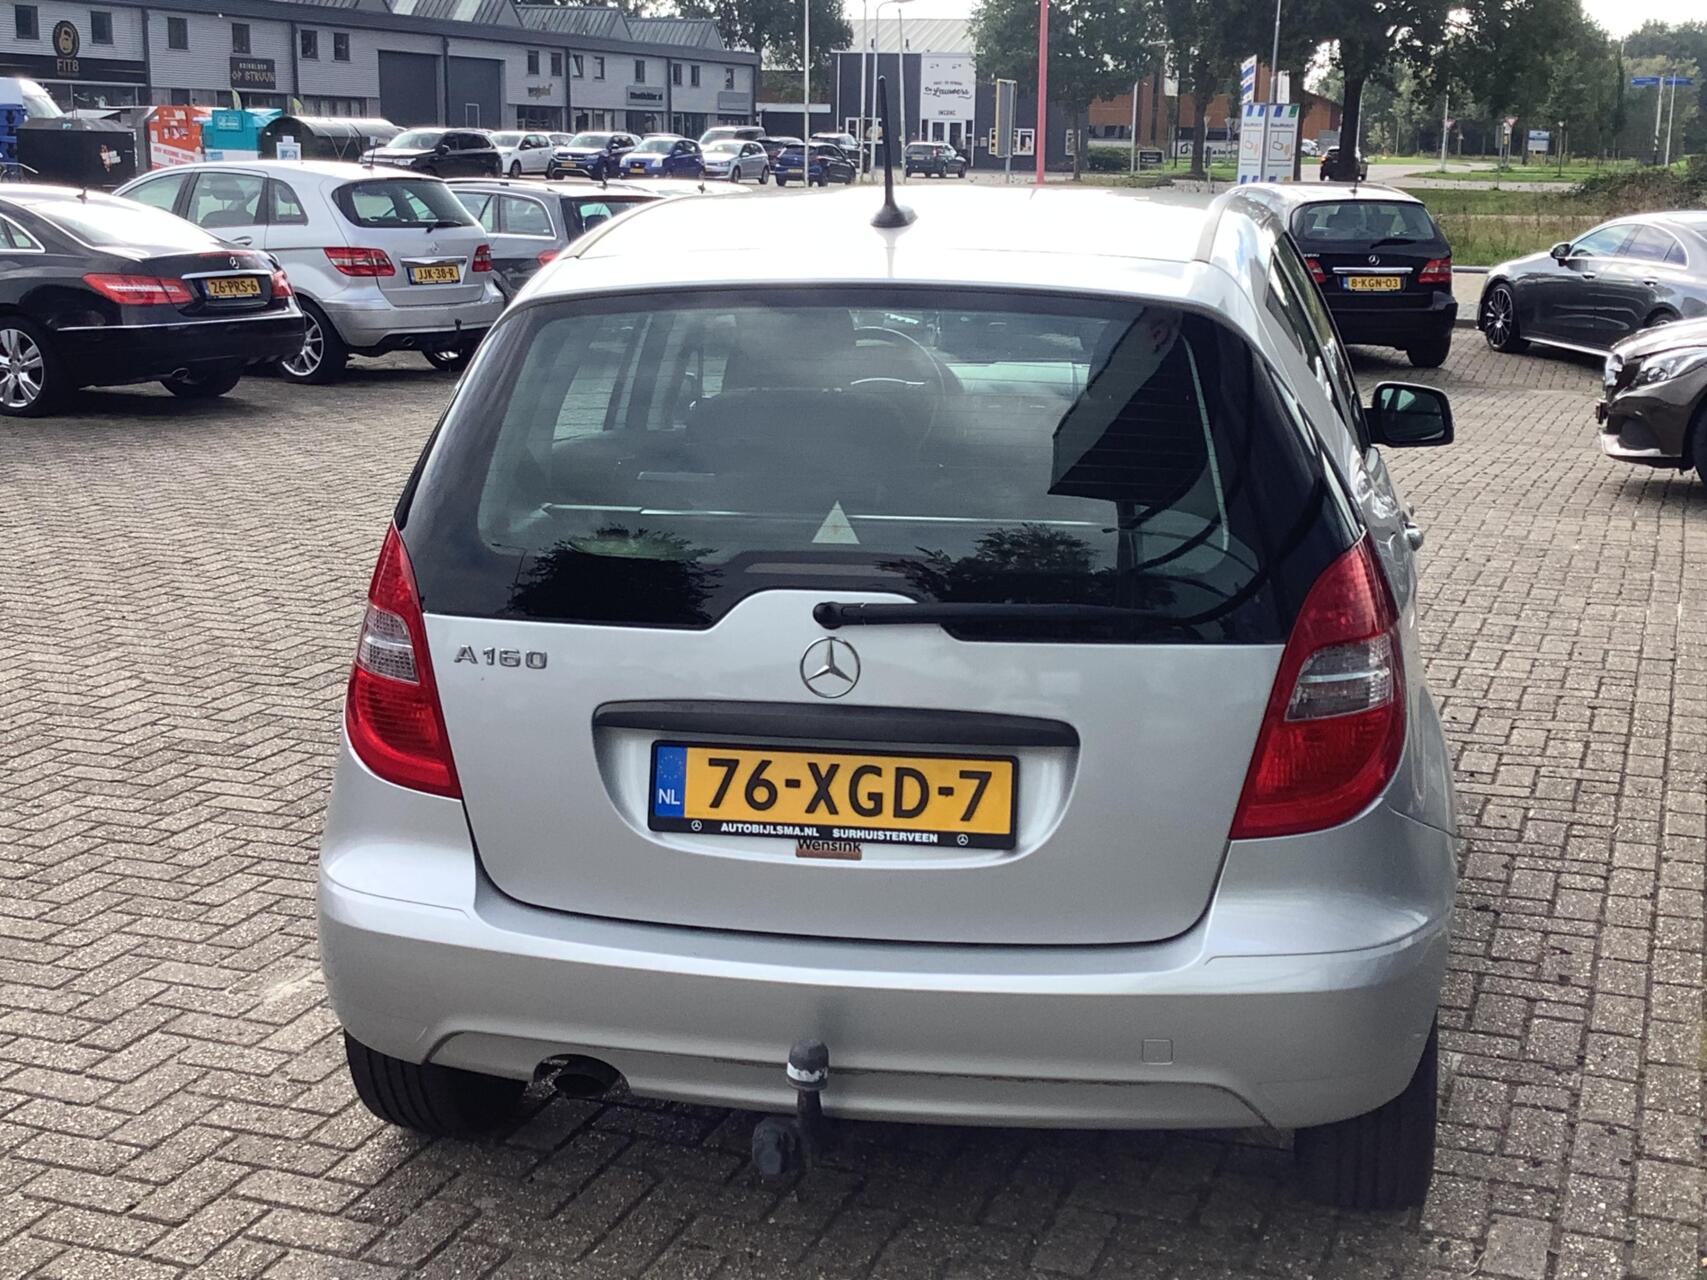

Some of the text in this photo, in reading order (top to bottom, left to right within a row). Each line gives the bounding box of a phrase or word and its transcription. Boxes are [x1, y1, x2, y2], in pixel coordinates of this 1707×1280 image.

[56, 59, 79, 72] FIT8
[211, 280, 258, 294] 26-PRS-6
[1350, 278, 1399, 288] 8-KGN-03
[707, 757, 993, 822] 76-XGD-7
[657, 788, 681, 806] NL
[720, 822, 938, 844] AUTOBIJLSMA.NL SURHUISTERVEEN
[797, 838, 862, 852] Wensink
